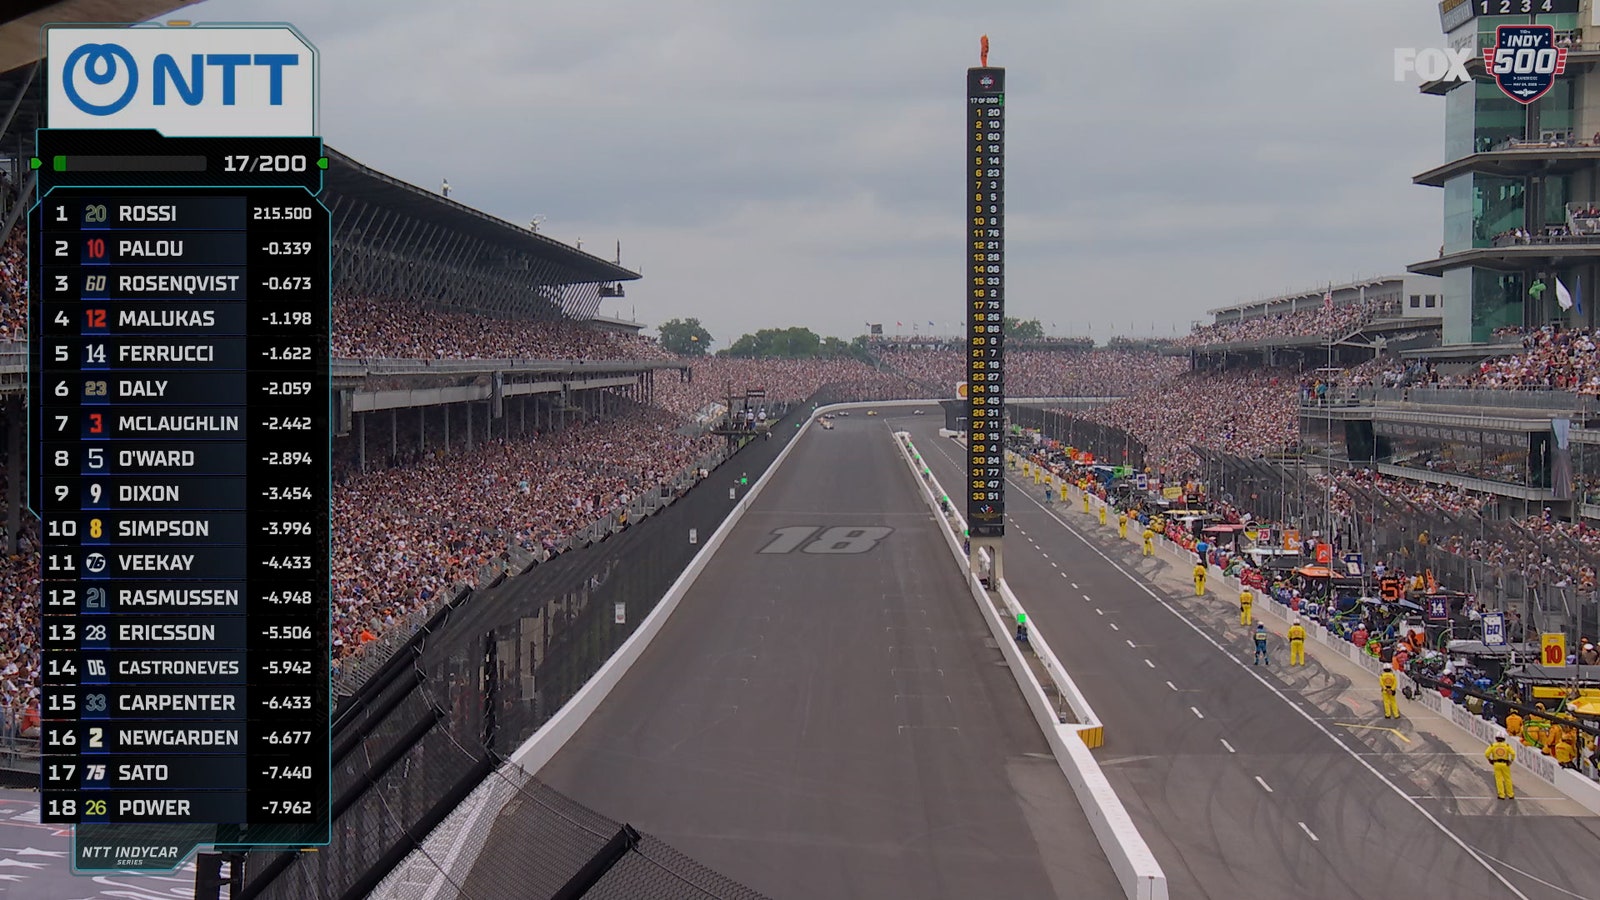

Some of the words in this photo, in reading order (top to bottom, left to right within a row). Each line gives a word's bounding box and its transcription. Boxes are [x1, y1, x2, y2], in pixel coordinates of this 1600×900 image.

[1481, 0, 1488, 14] 1
[1500, 0, 1511, 13] 2
[1520, 0, 1531, 12] 3
[1541, 0, 1552, 11] 4
[991, 193, 996, 201] 5
[757, 525, 895, 554] 18
[1259, 529, 1269, 539] 75
[1381, 579, 1399, 602] 5
[1431, 602, 1444, 614] 14
[1486, 624, 1500, 635] 60
[1545, 645, 1563, 664] 10
